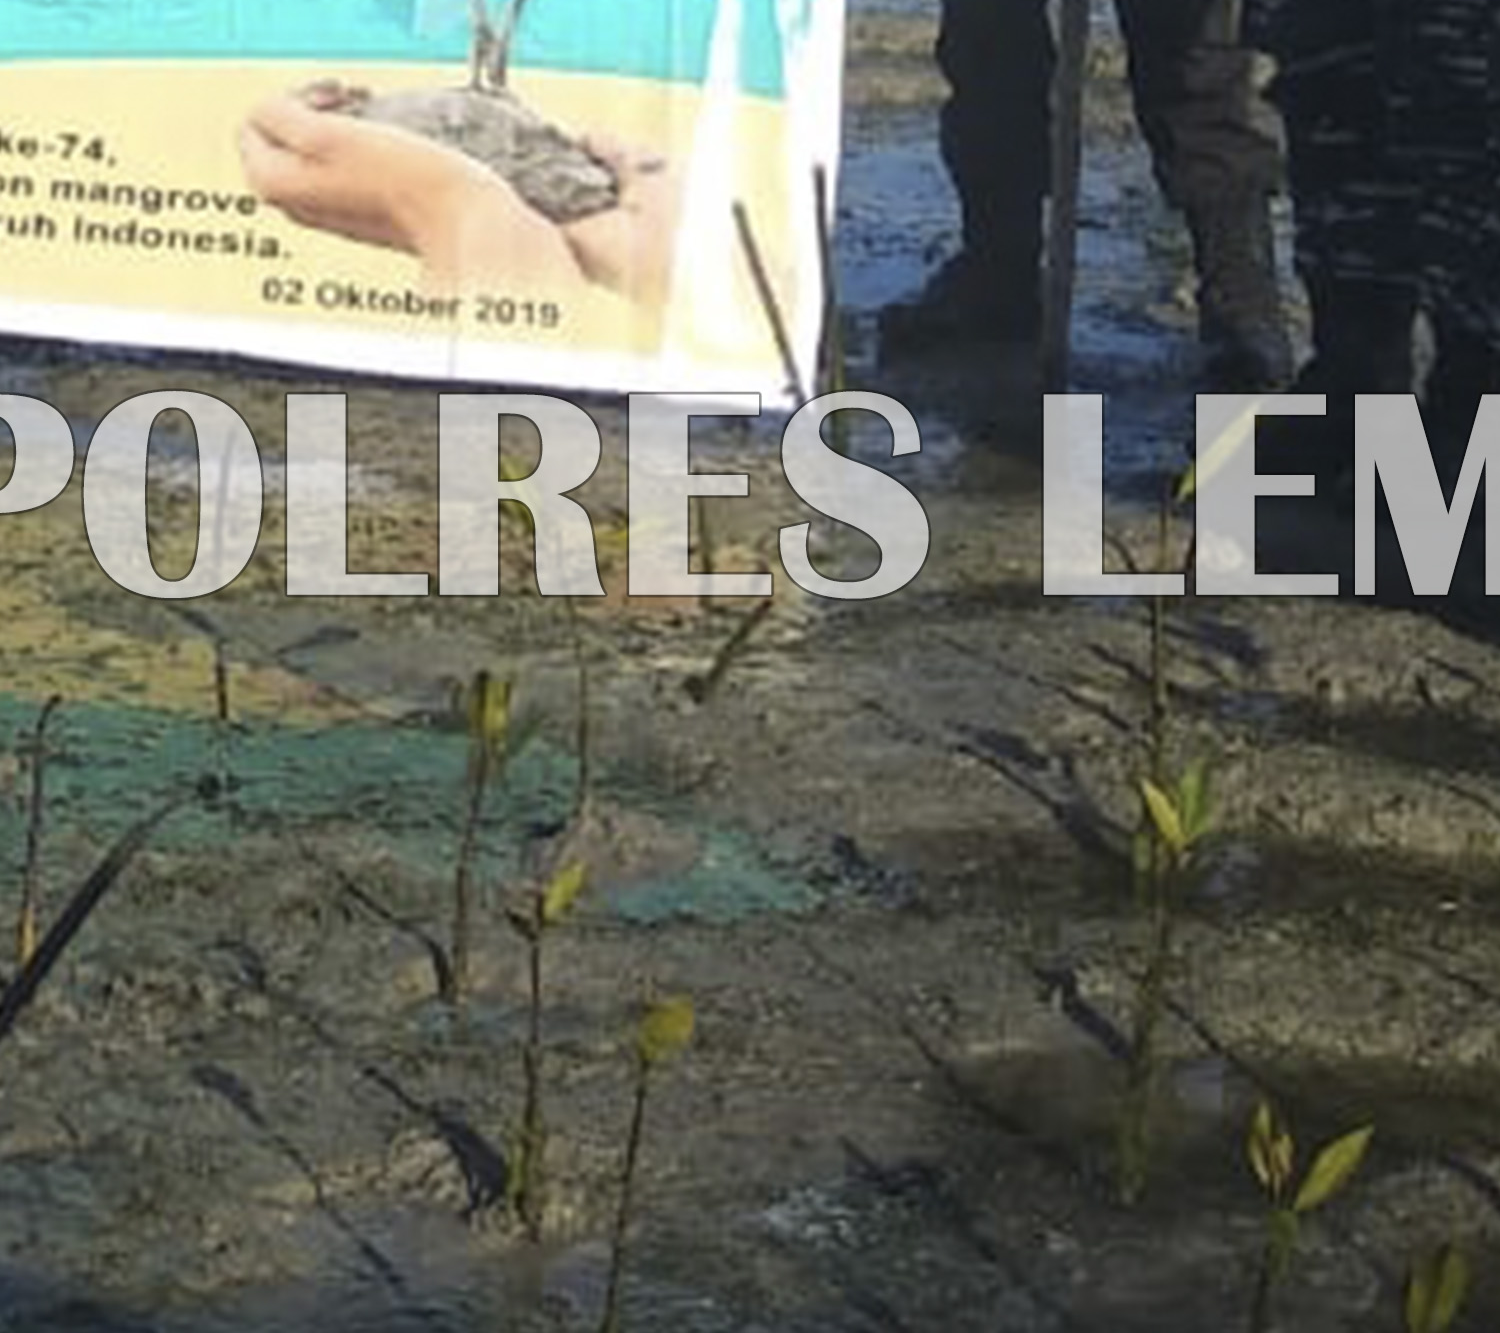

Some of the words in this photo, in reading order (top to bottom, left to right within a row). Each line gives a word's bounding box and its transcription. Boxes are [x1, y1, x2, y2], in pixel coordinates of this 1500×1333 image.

[49, 177, 261, 217] mangrove
[260, 277, 305, 305] 02
[315, 280, 464, 320] Oktober
[473, 295, 562, 329] 2019
